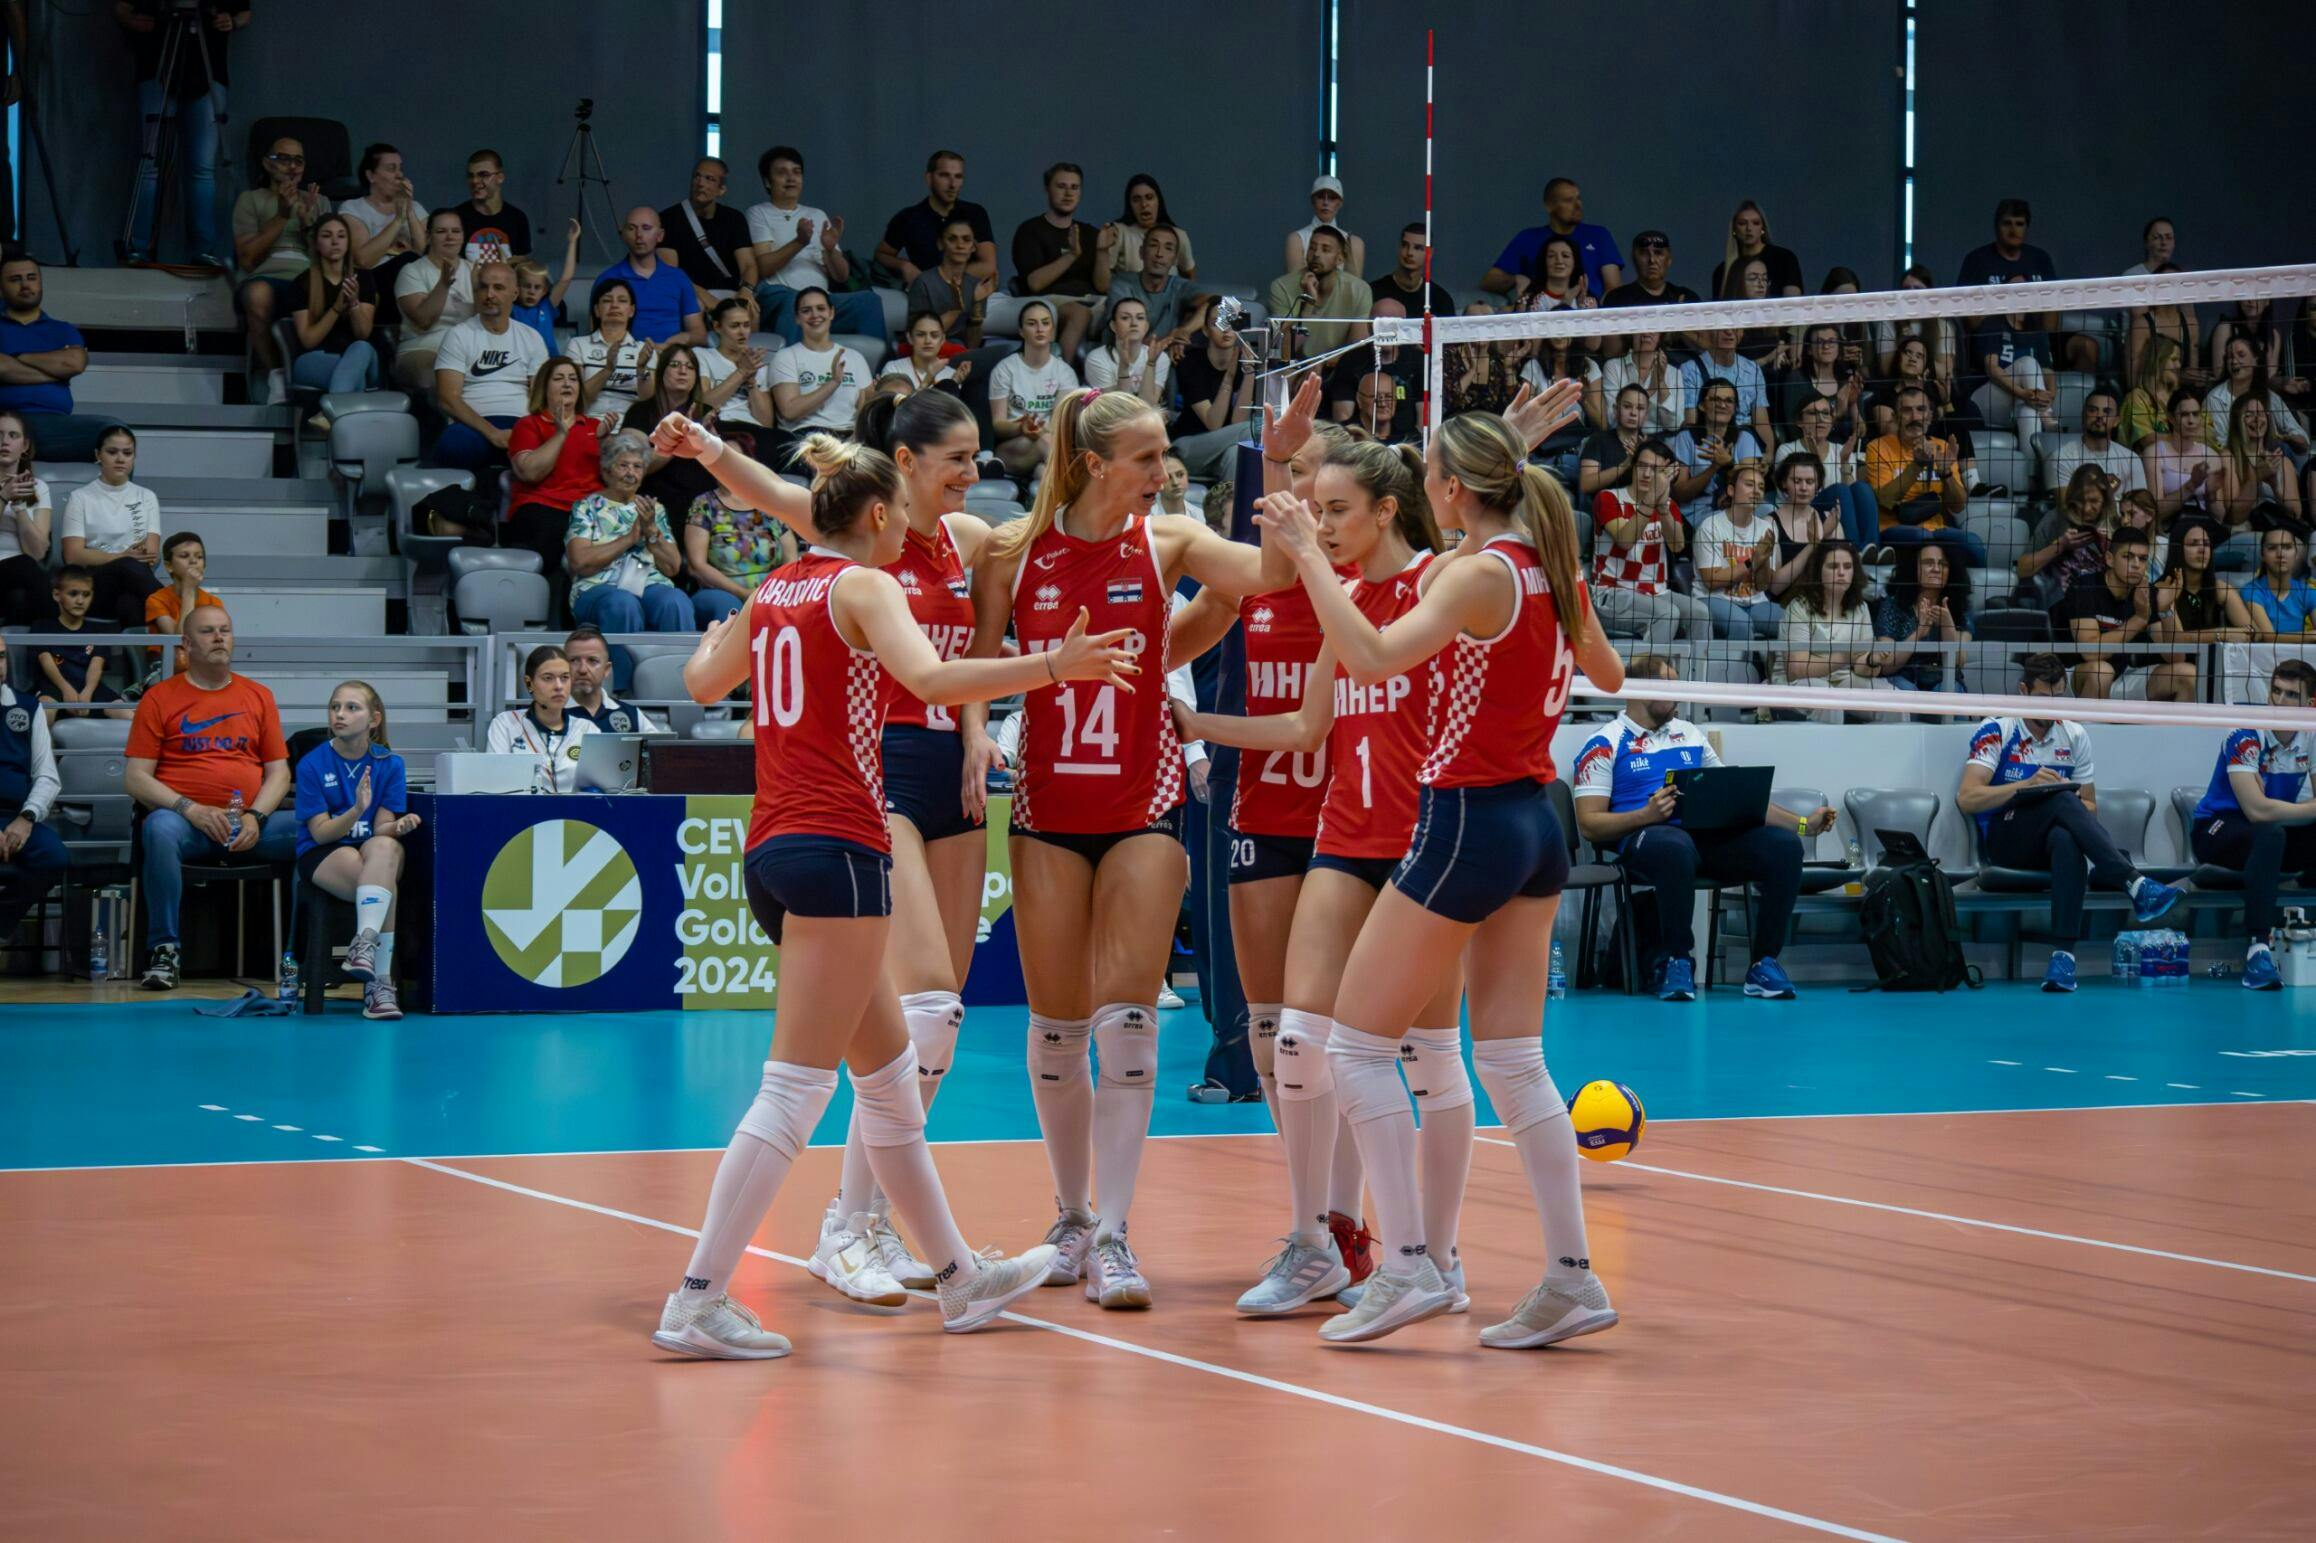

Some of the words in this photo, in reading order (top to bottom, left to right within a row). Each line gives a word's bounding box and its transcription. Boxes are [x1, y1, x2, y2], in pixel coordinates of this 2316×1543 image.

[479, 350, 511, 366] NIKE
[1520, 566, 1551, 596] MIH
[751, 625, 805, 728] 10
[1055, 685, 1120, 758] 14
[1355, 735, 1373, 809] 1
[1230, 838, 1256, 869] 20
[674, 861, 748, 901] Vol
[673, 956, 777, 994] 2024
